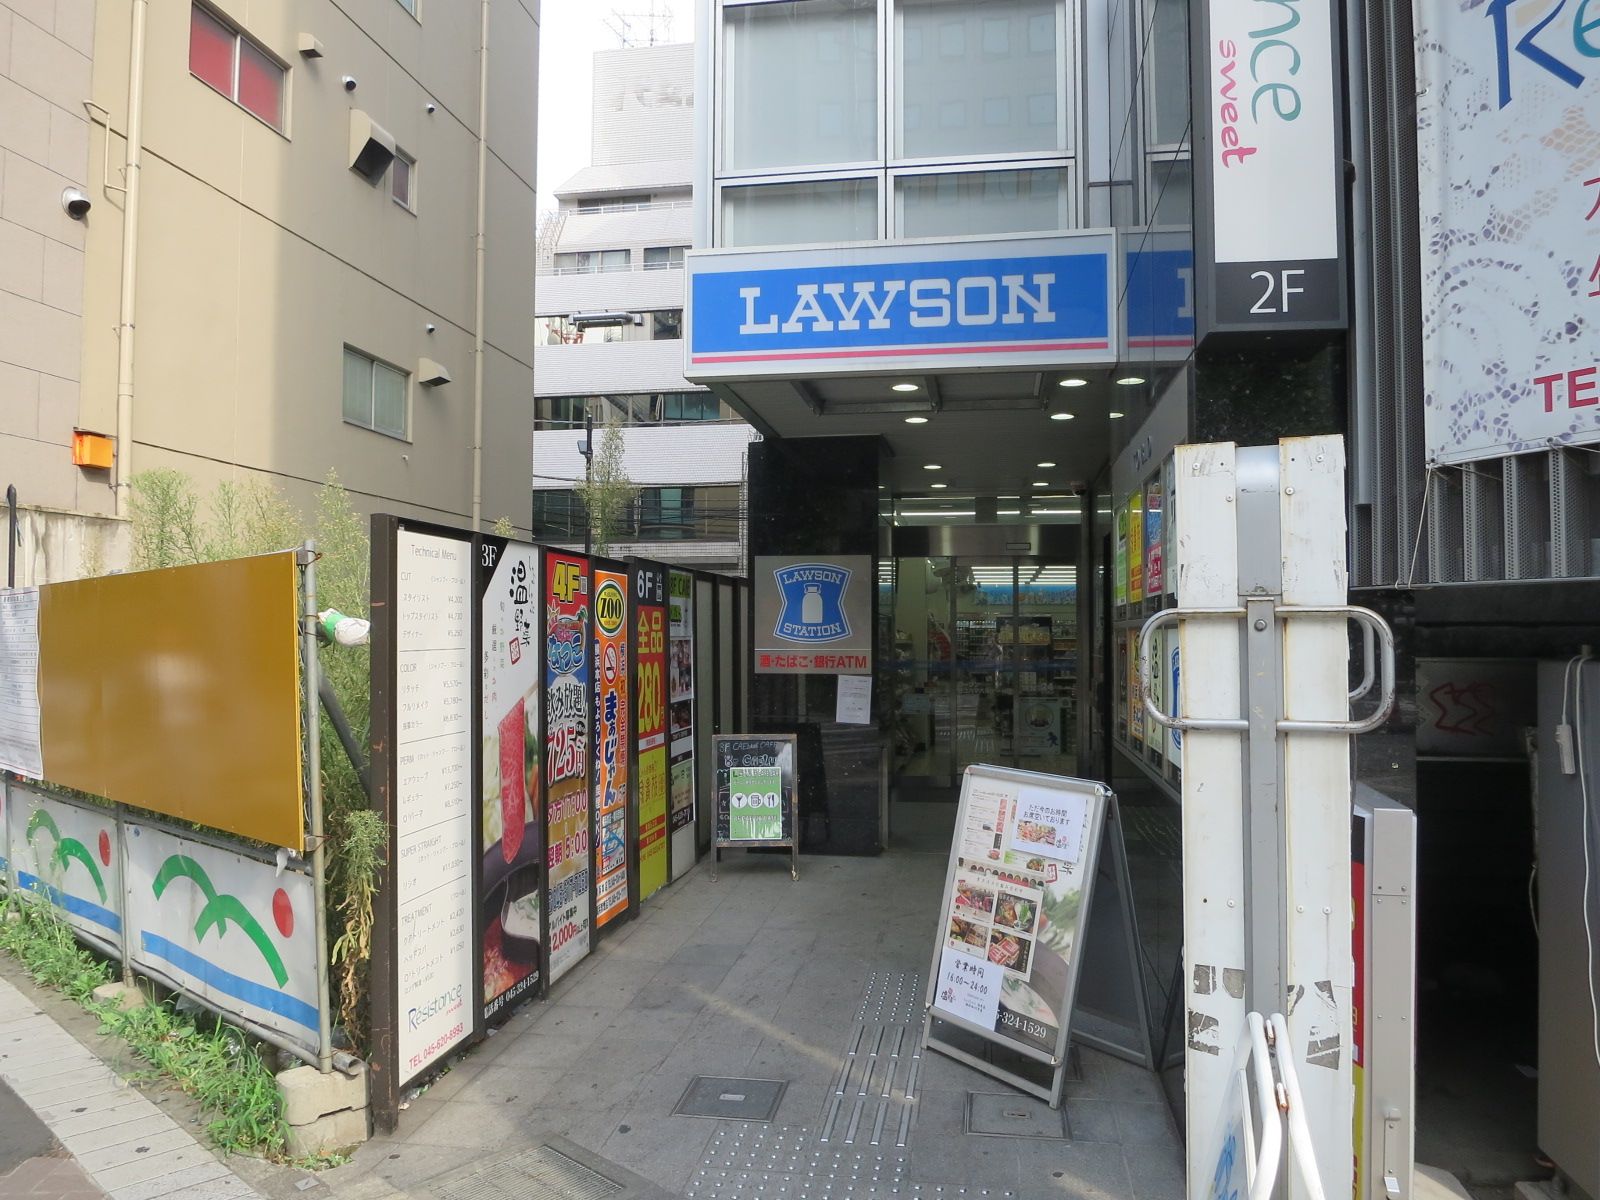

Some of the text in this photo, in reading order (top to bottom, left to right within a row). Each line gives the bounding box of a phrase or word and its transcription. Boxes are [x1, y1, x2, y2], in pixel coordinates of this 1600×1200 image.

[1219, 39, 1257, 168] sweet
[739, 273, 1056, 335] LAWSON
[1249, 269, 1305, 314] 2F
[411, 544, 440, 559] Technical
[481, 543, 497, 566] 3F
[552, 560, 581, 602] 4F
[637, 570, 653, 598] 6F
[783, 570, 843, 584] LAWSON
[600, 597, 622, 619] ZOO
[783, 622, 842, 637] STATION
[638, 661, 661, 734] 280
[565, 829, 588, 857] 5:00
[408, 1053, 422, 1071] TEL
